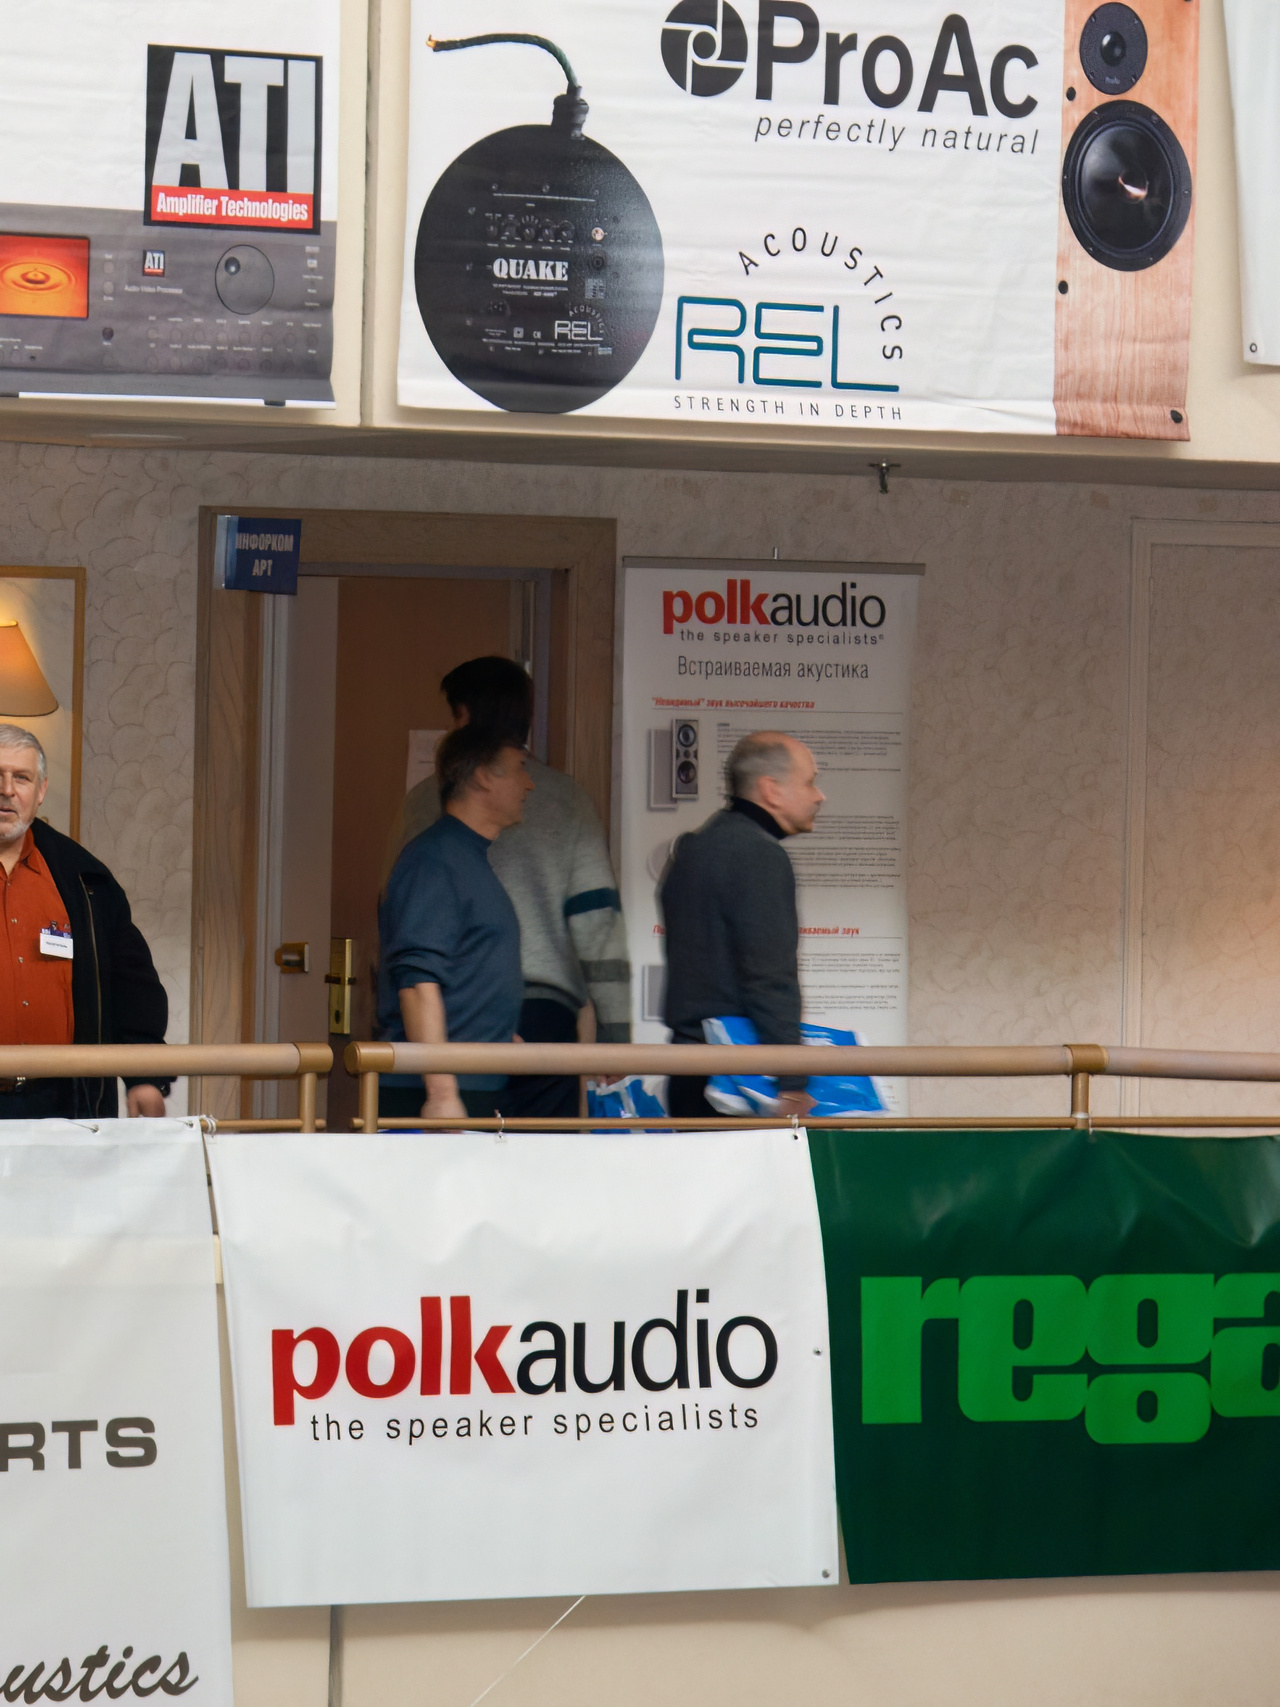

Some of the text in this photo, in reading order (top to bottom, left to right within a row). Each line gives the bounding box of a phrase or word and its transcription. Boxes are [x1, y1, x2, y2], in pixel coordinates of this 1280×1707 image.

[755, 0, 1039, 119] ProAc
[152, 51, 316, 195] ATI
[755, 114, 1039, 154] perfectly natural
[156, 192, 308, 222] Amplifier Technologies
[143, 251, 165, 270] ATI
[493, 258, 569, 282] QUAKE
[738, 227, 903, 360] ACOUSTICS
[554, 320, 603, 341] REL
[675, 295, 900, 392] REL
[674, 395, 902, 420] STRENGTH IN DEPTH
[235, 532, 294, 552] ИНФОРКОМ
[252, 559, 273, 576] АРТ
[680, 628, 705, 642] the
[713, 630, 778, 645] speaker
[678, 655, 869, 682] Встраиваемая акустика
[271, 1288, 778, 1426] polkaudio
[310, 1402, 759, 1446] the speaker specialists
